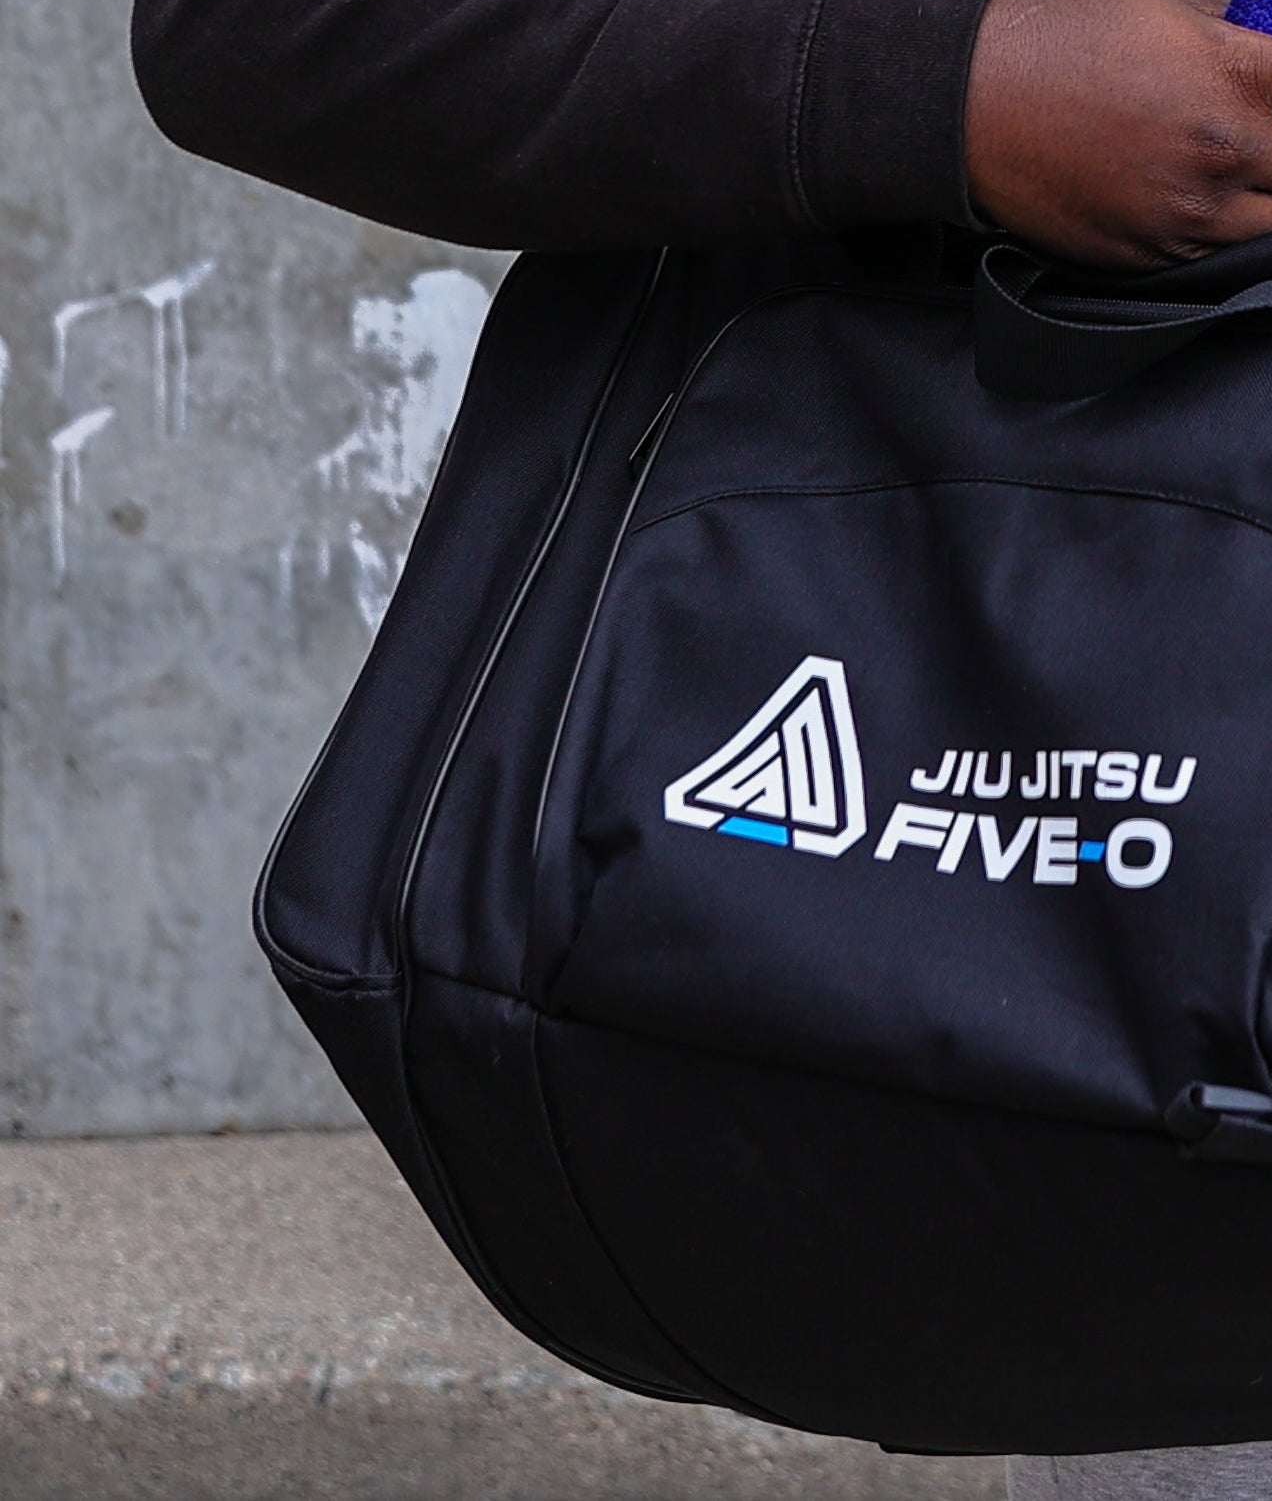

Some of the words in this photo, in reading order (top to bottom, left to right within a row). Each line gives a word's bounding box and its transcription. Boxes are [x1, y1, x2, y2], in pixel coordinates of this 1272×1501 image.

[910, 749, 1012, 799] JIU
[1020, 750, 1198, 804] JITSU
[873, 802, 1174, 889] FIVE-O
